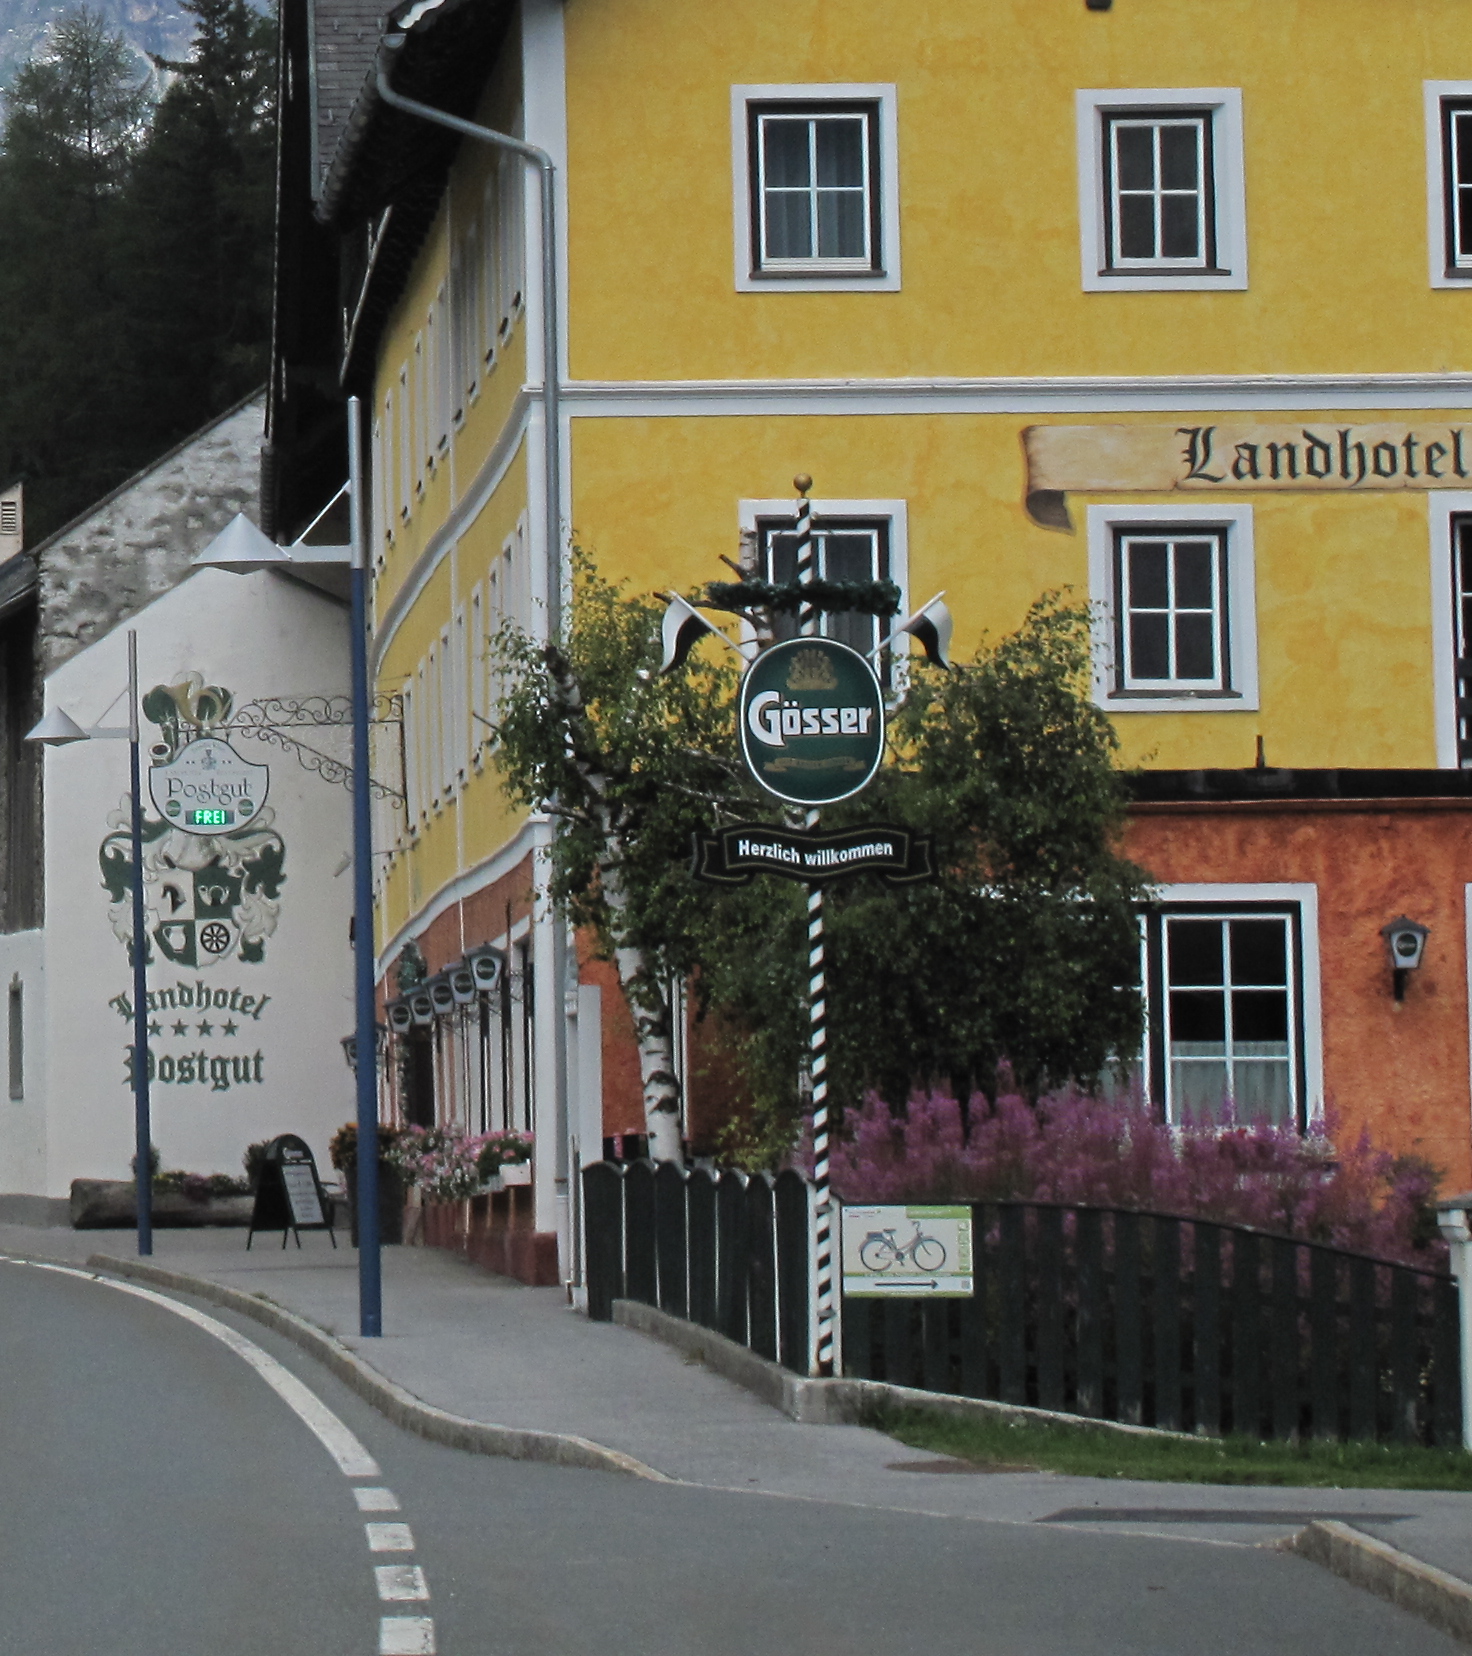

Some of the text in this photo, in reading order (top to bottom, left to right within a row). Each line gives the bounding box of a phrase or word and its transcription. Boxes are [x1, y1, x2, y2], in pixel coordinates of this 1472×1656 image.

[1175, 426, 1469, 488] Landhotel
[748, 690, 872, 746] Gösser
[165, 777, 253, 806] Postgut
[195, 810, 226, 825] FREI
[738, 839, 893, 866] Herzlich willkommen
[108, 979, 272, 1025] Landhotel
